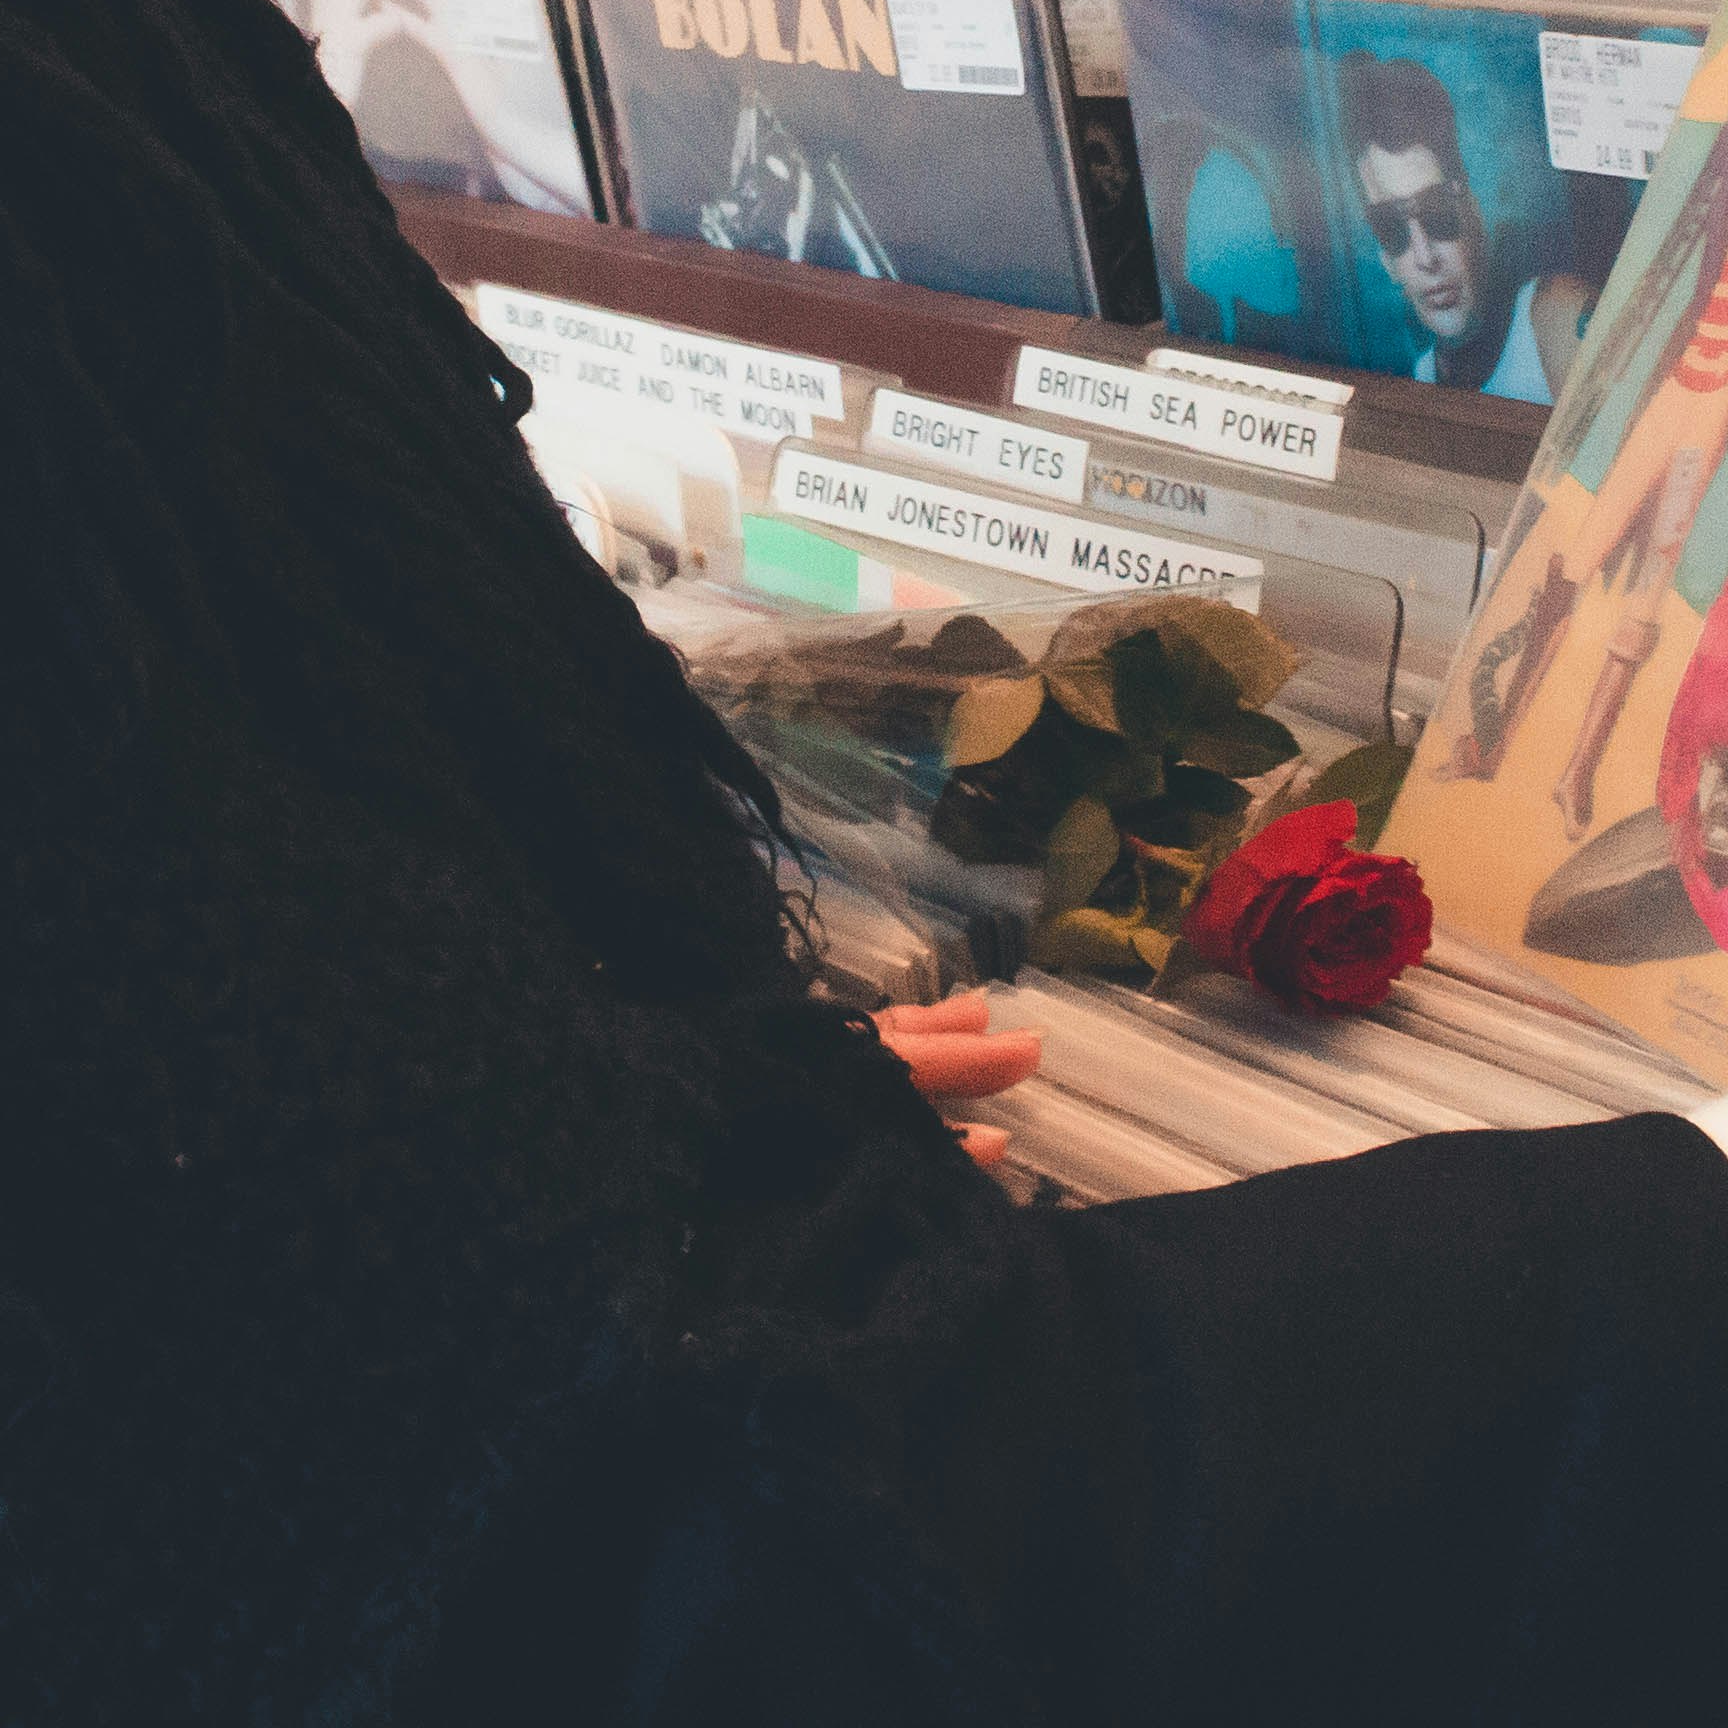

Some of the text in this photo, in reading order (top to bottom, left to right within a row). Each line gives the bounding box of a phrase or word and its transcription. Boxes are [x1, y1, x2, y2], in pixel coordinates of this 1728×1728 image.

[504, 301, 827, 403] BLUR GORILLAZ DAMON ALBARN
[576, 358, 623, 394] JUICE
[636, 373, 677, 406] AND
[689, 386, 725, 418] THE
[739, 398, 798, 434] MOON
[890, 409, 1068, 481] BRIGHT EYES
[1035, 364, 1133, 415] BRITISH
[1148, 391, 1199, 431] SEA
[1220, 407, 1319, 458] POWER
[794, 470, 869, 515] BRIAN
[886, 493, 1050, 562] JONESTOWN
